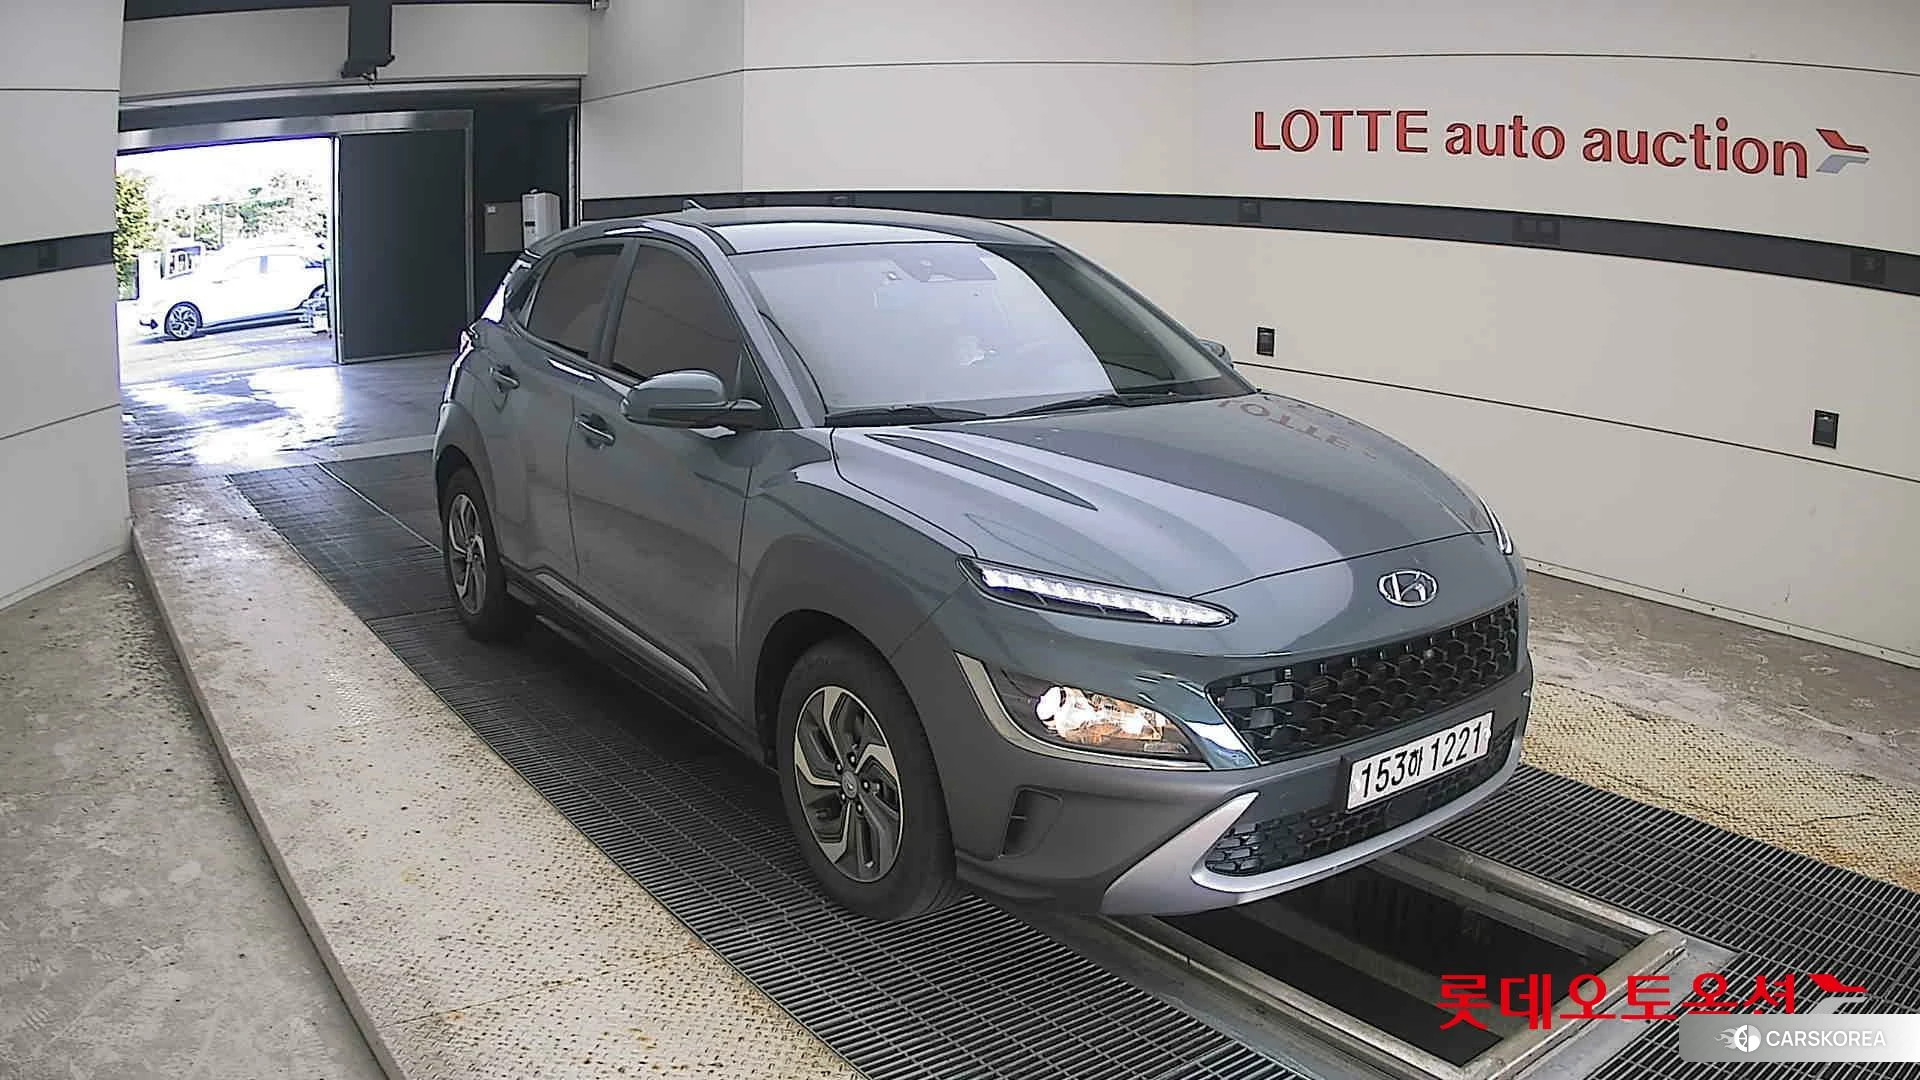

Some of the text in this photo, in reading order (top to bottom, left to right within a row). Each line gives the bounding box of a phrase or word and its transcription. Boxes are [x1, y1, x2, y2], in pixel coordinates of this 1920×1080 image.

[1254, 110, 1808, 179] LOTTE auto auction
[1431, 721, 1482, 772] 1221
